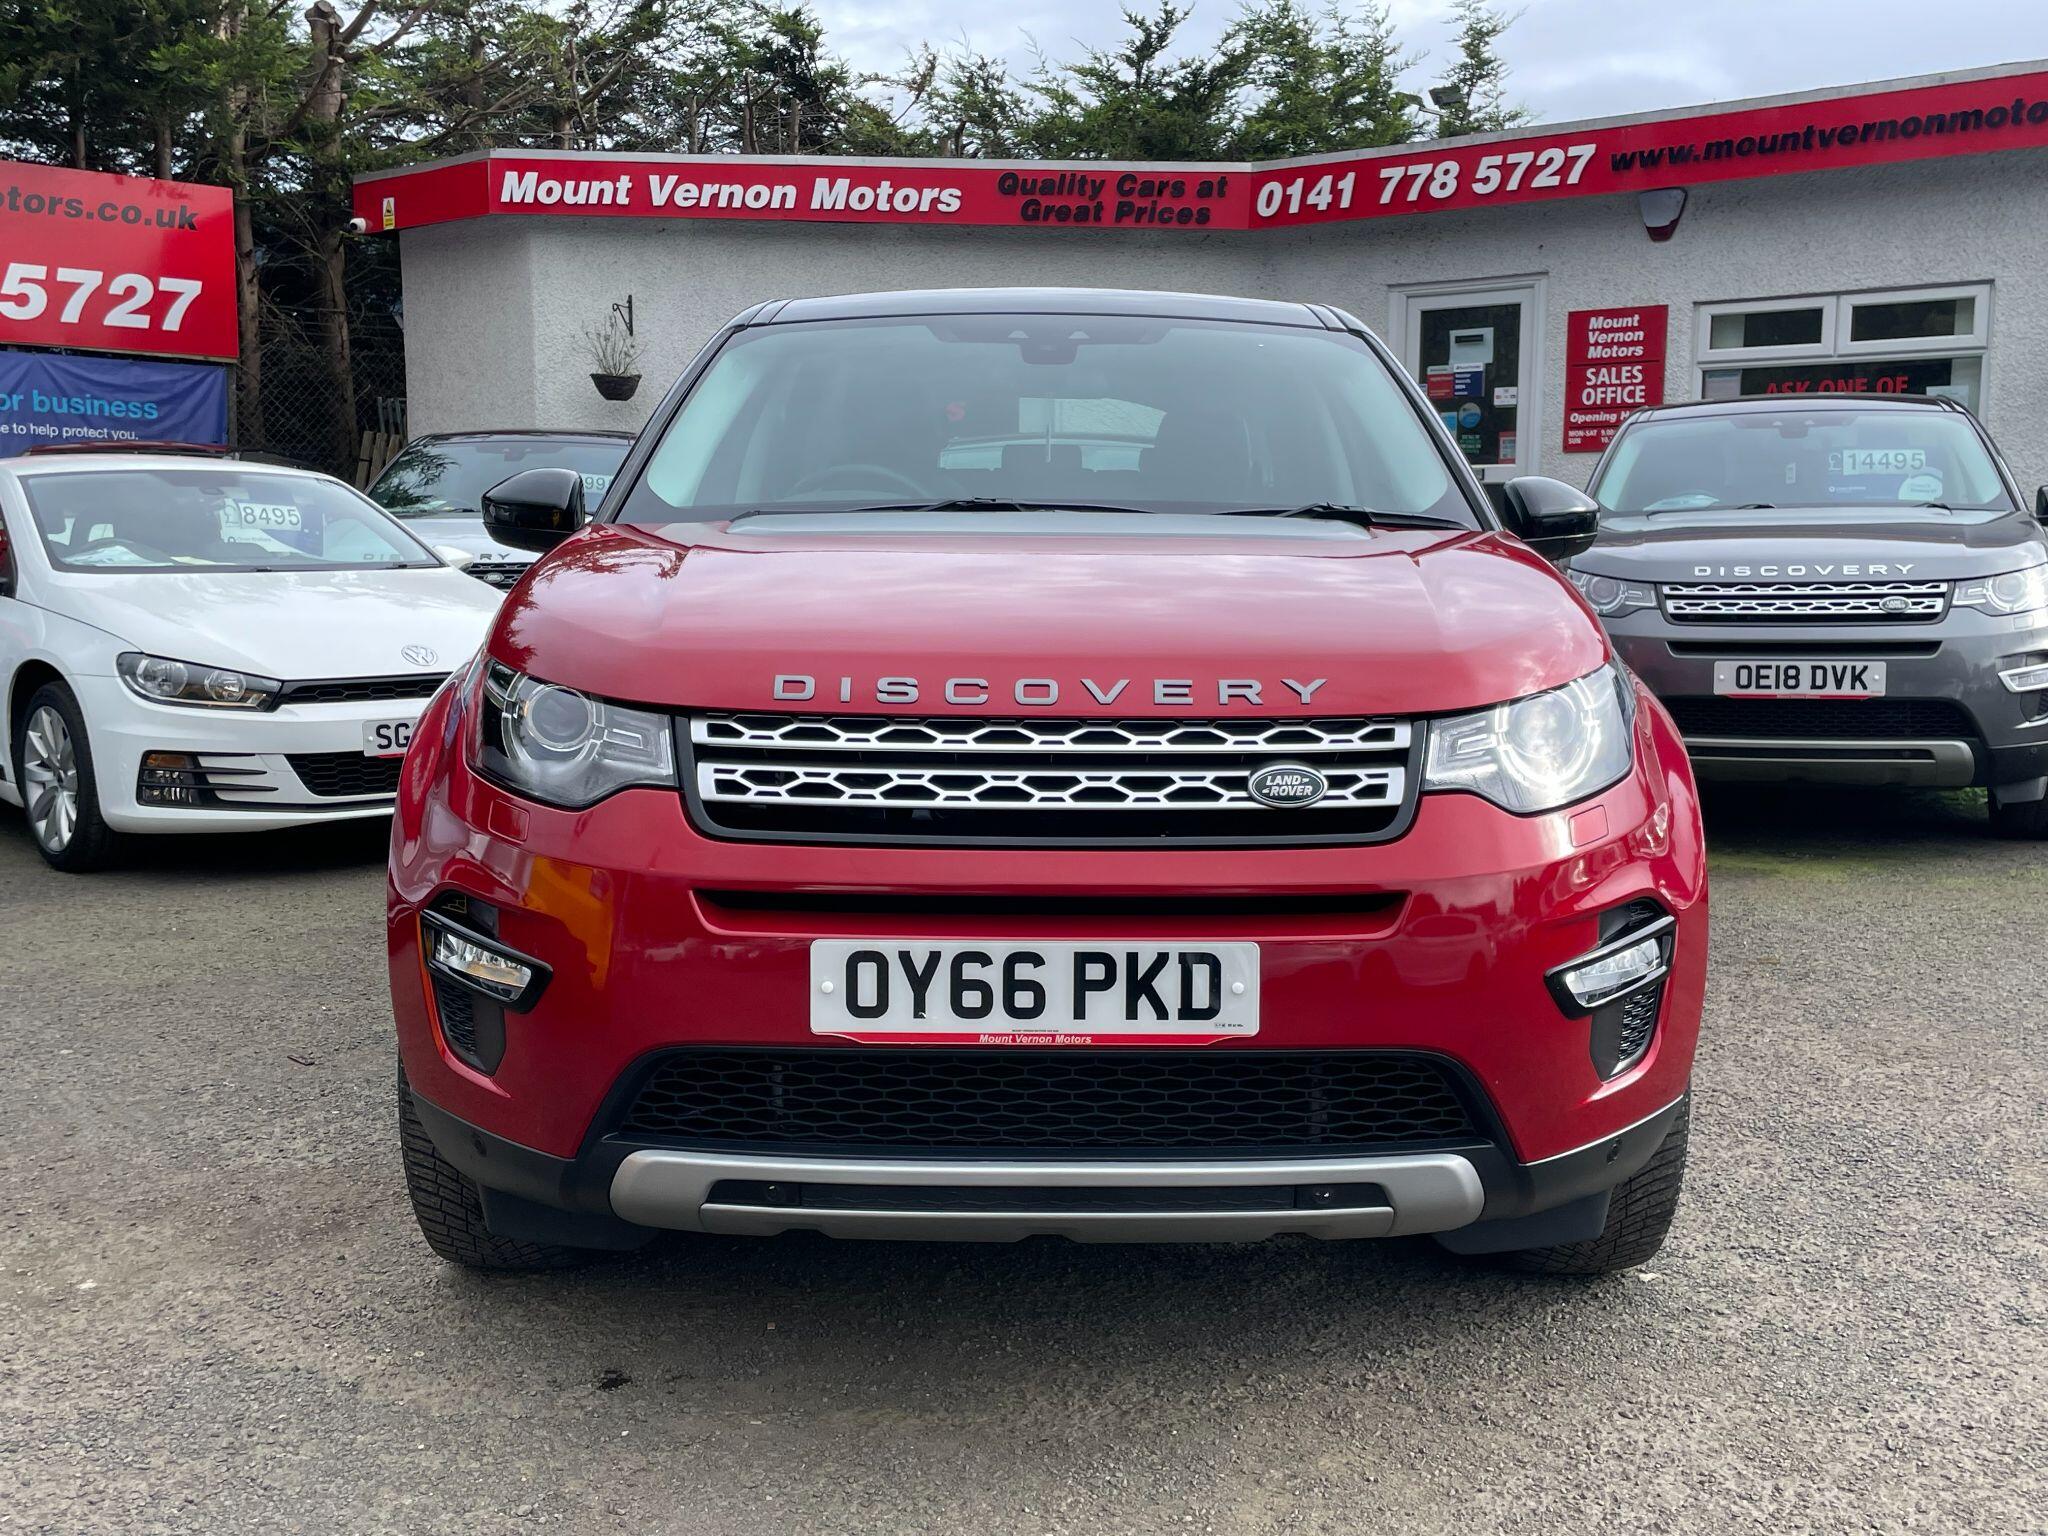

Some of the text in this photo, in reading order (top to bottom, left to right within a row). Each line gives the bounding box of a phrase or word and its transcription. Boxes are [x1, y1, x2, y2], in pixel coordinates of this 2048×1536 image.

[501, 170, 962, 213] Mount Vernon Motors
[998, 171, 1229, 200] Quality Cars at
[1256, 144, 1597, 218] 0141 778 5727
[0, 185, 200, 231] tors.co.uk
[1020, 198, 1211, 225] Great Prices
[0, 262, 203, 332] 5727
[1588, 313, 1640, 330] Mount
[1588, 329, 1645, 344] Vernon
[1587, 344, 1645, 360] Motors
[1585, 365, 1644, 386] SALES
[1818, 377, 1868, 394] ONE
[1876, 375, 1909, 394] OF
[32, 389, 159, 419] business
[1581, 385, 1646, 406] OFFICE
[1570, 411, 1617, 424] Opening
[12, 423, 27, 434] to
[30, 423, 59, 438] help
[62, 427, 108, 439] protect
[110, 430, 140, 441] you.
[1694, 563, 1917, 578] DISCOVERY
[1735, 664, 1869, 690] OE18 DVK
[773, 673, 1329, 707] DISCOVERY
[375, 722, 411, 750] SG
[1266, 775, 1302, 786] LAND
[1269, 785, 1313, 797] ROVER
[844, 949, 1223, 1021] OY66 PKD
[980, 1034, 1092, 1044] Mount Vernon Motors
